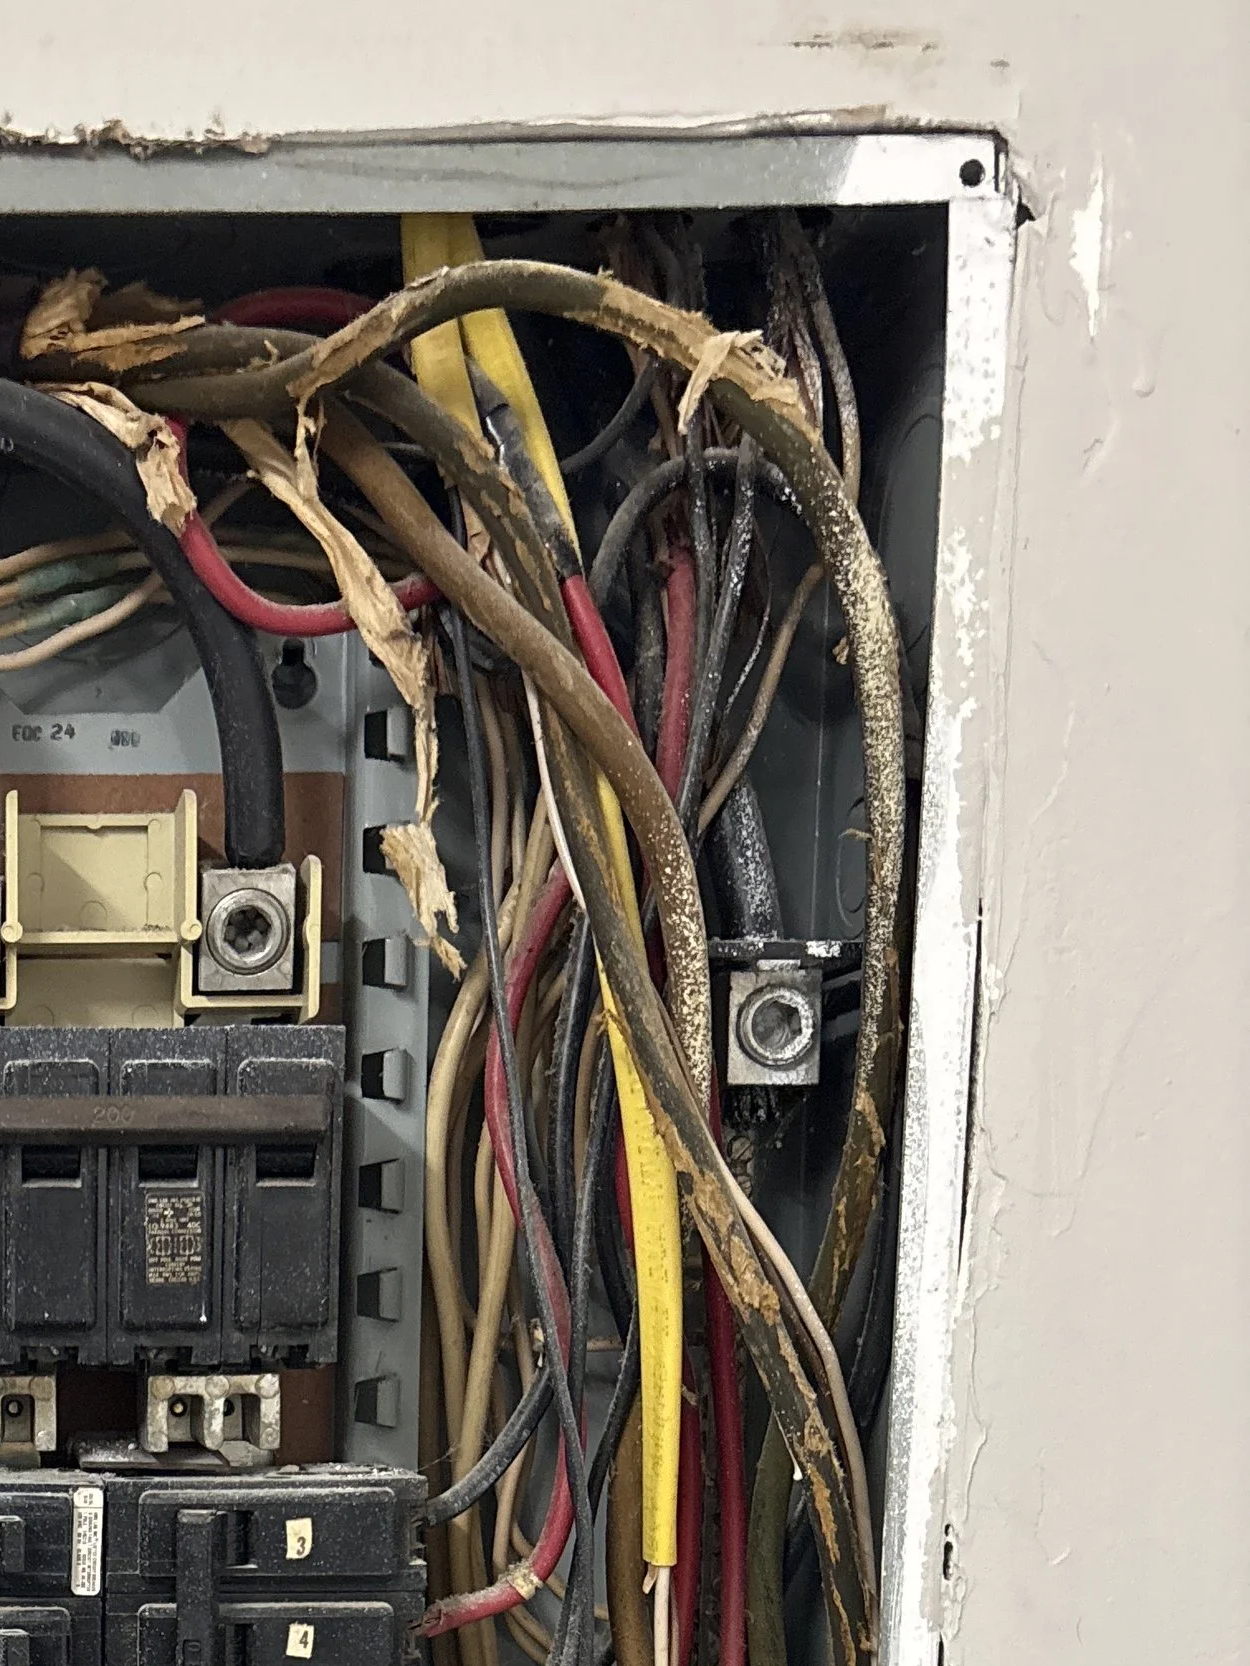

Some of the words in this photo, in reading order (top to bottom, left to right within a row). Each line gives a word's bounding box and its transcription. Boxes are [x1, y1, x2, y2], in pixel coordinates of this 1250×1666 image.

[50, 722, 76, 741] 24
[296, 1536, 307, 1556] 3
[299, 1630, 309, 1649] 4
